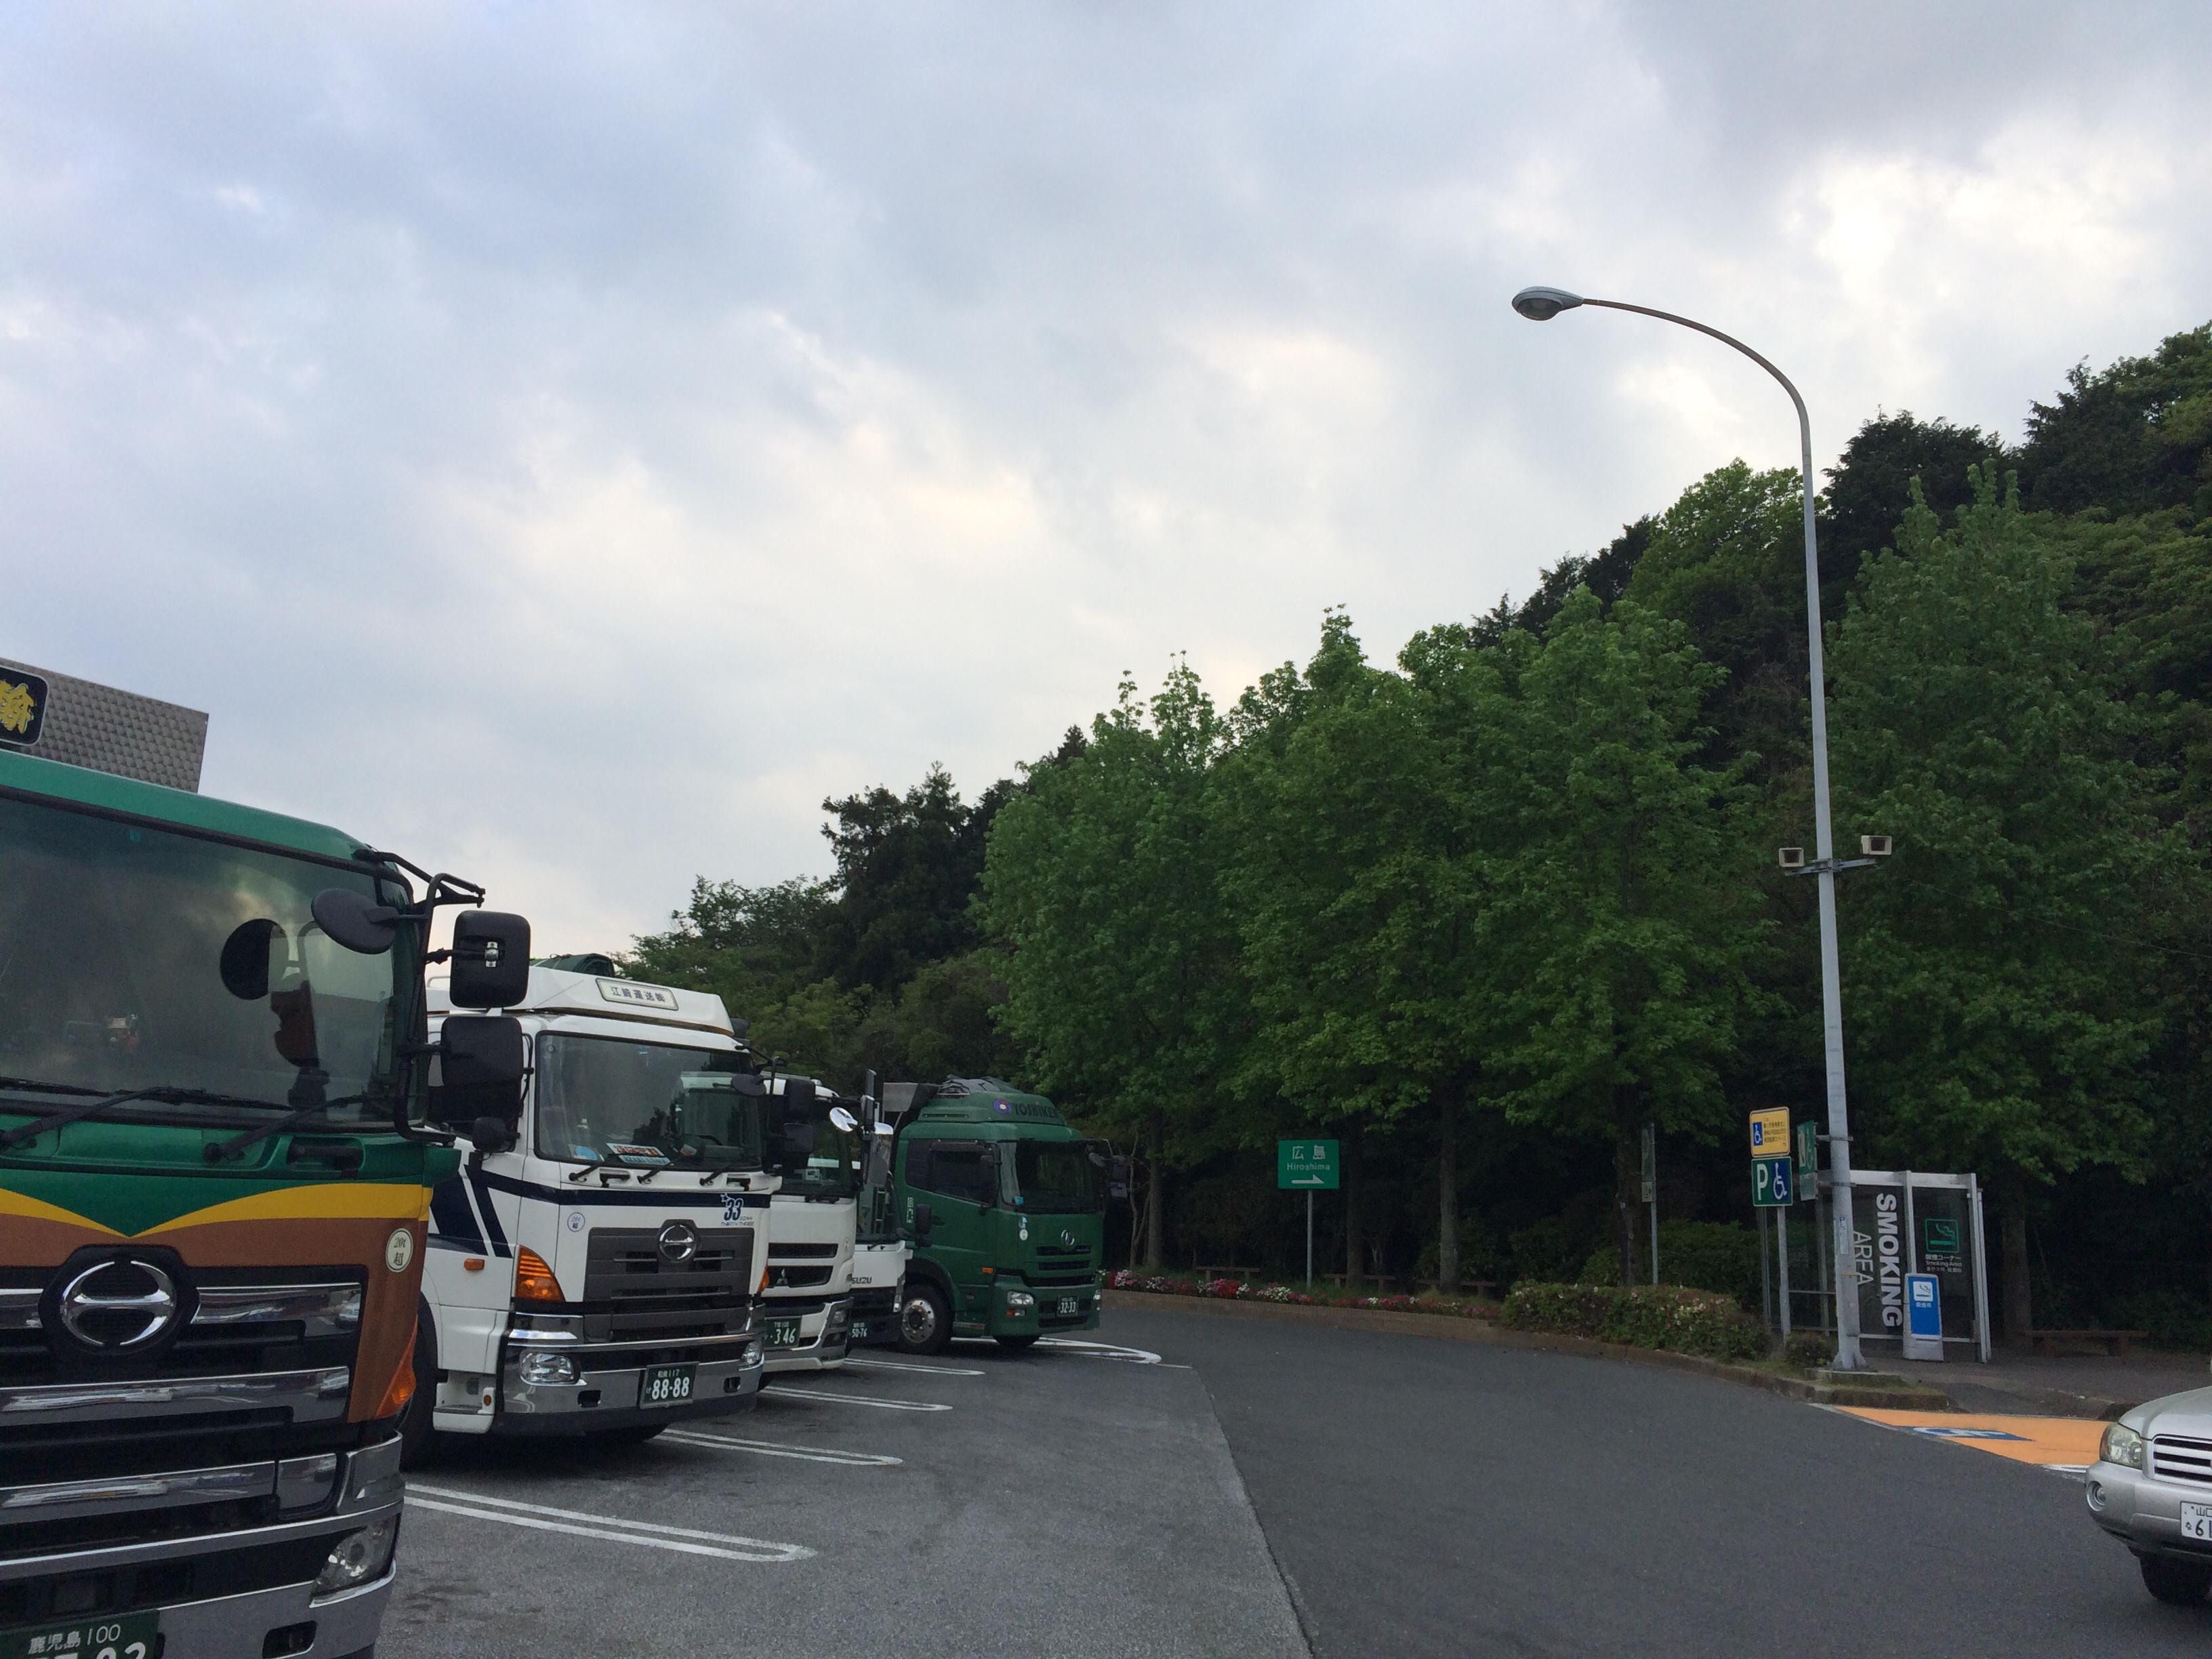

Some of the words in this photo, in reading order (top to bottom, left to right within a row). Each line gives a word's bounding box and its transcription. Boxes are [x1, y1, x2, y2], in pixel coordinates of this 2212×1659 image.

[1287, 1162, 1330, 1171] Hiroshima
[1757, 1163, 1768, 1201] P
[723, 1197, 744, 1221] 33
[1853, 1230, 1875, 1286] AREA
[1876, 1192, 1903, 1327] SMOKING
[28, 1631, 81, 1655] 鹿児島
[87, 1624, 121, 1645] 100
